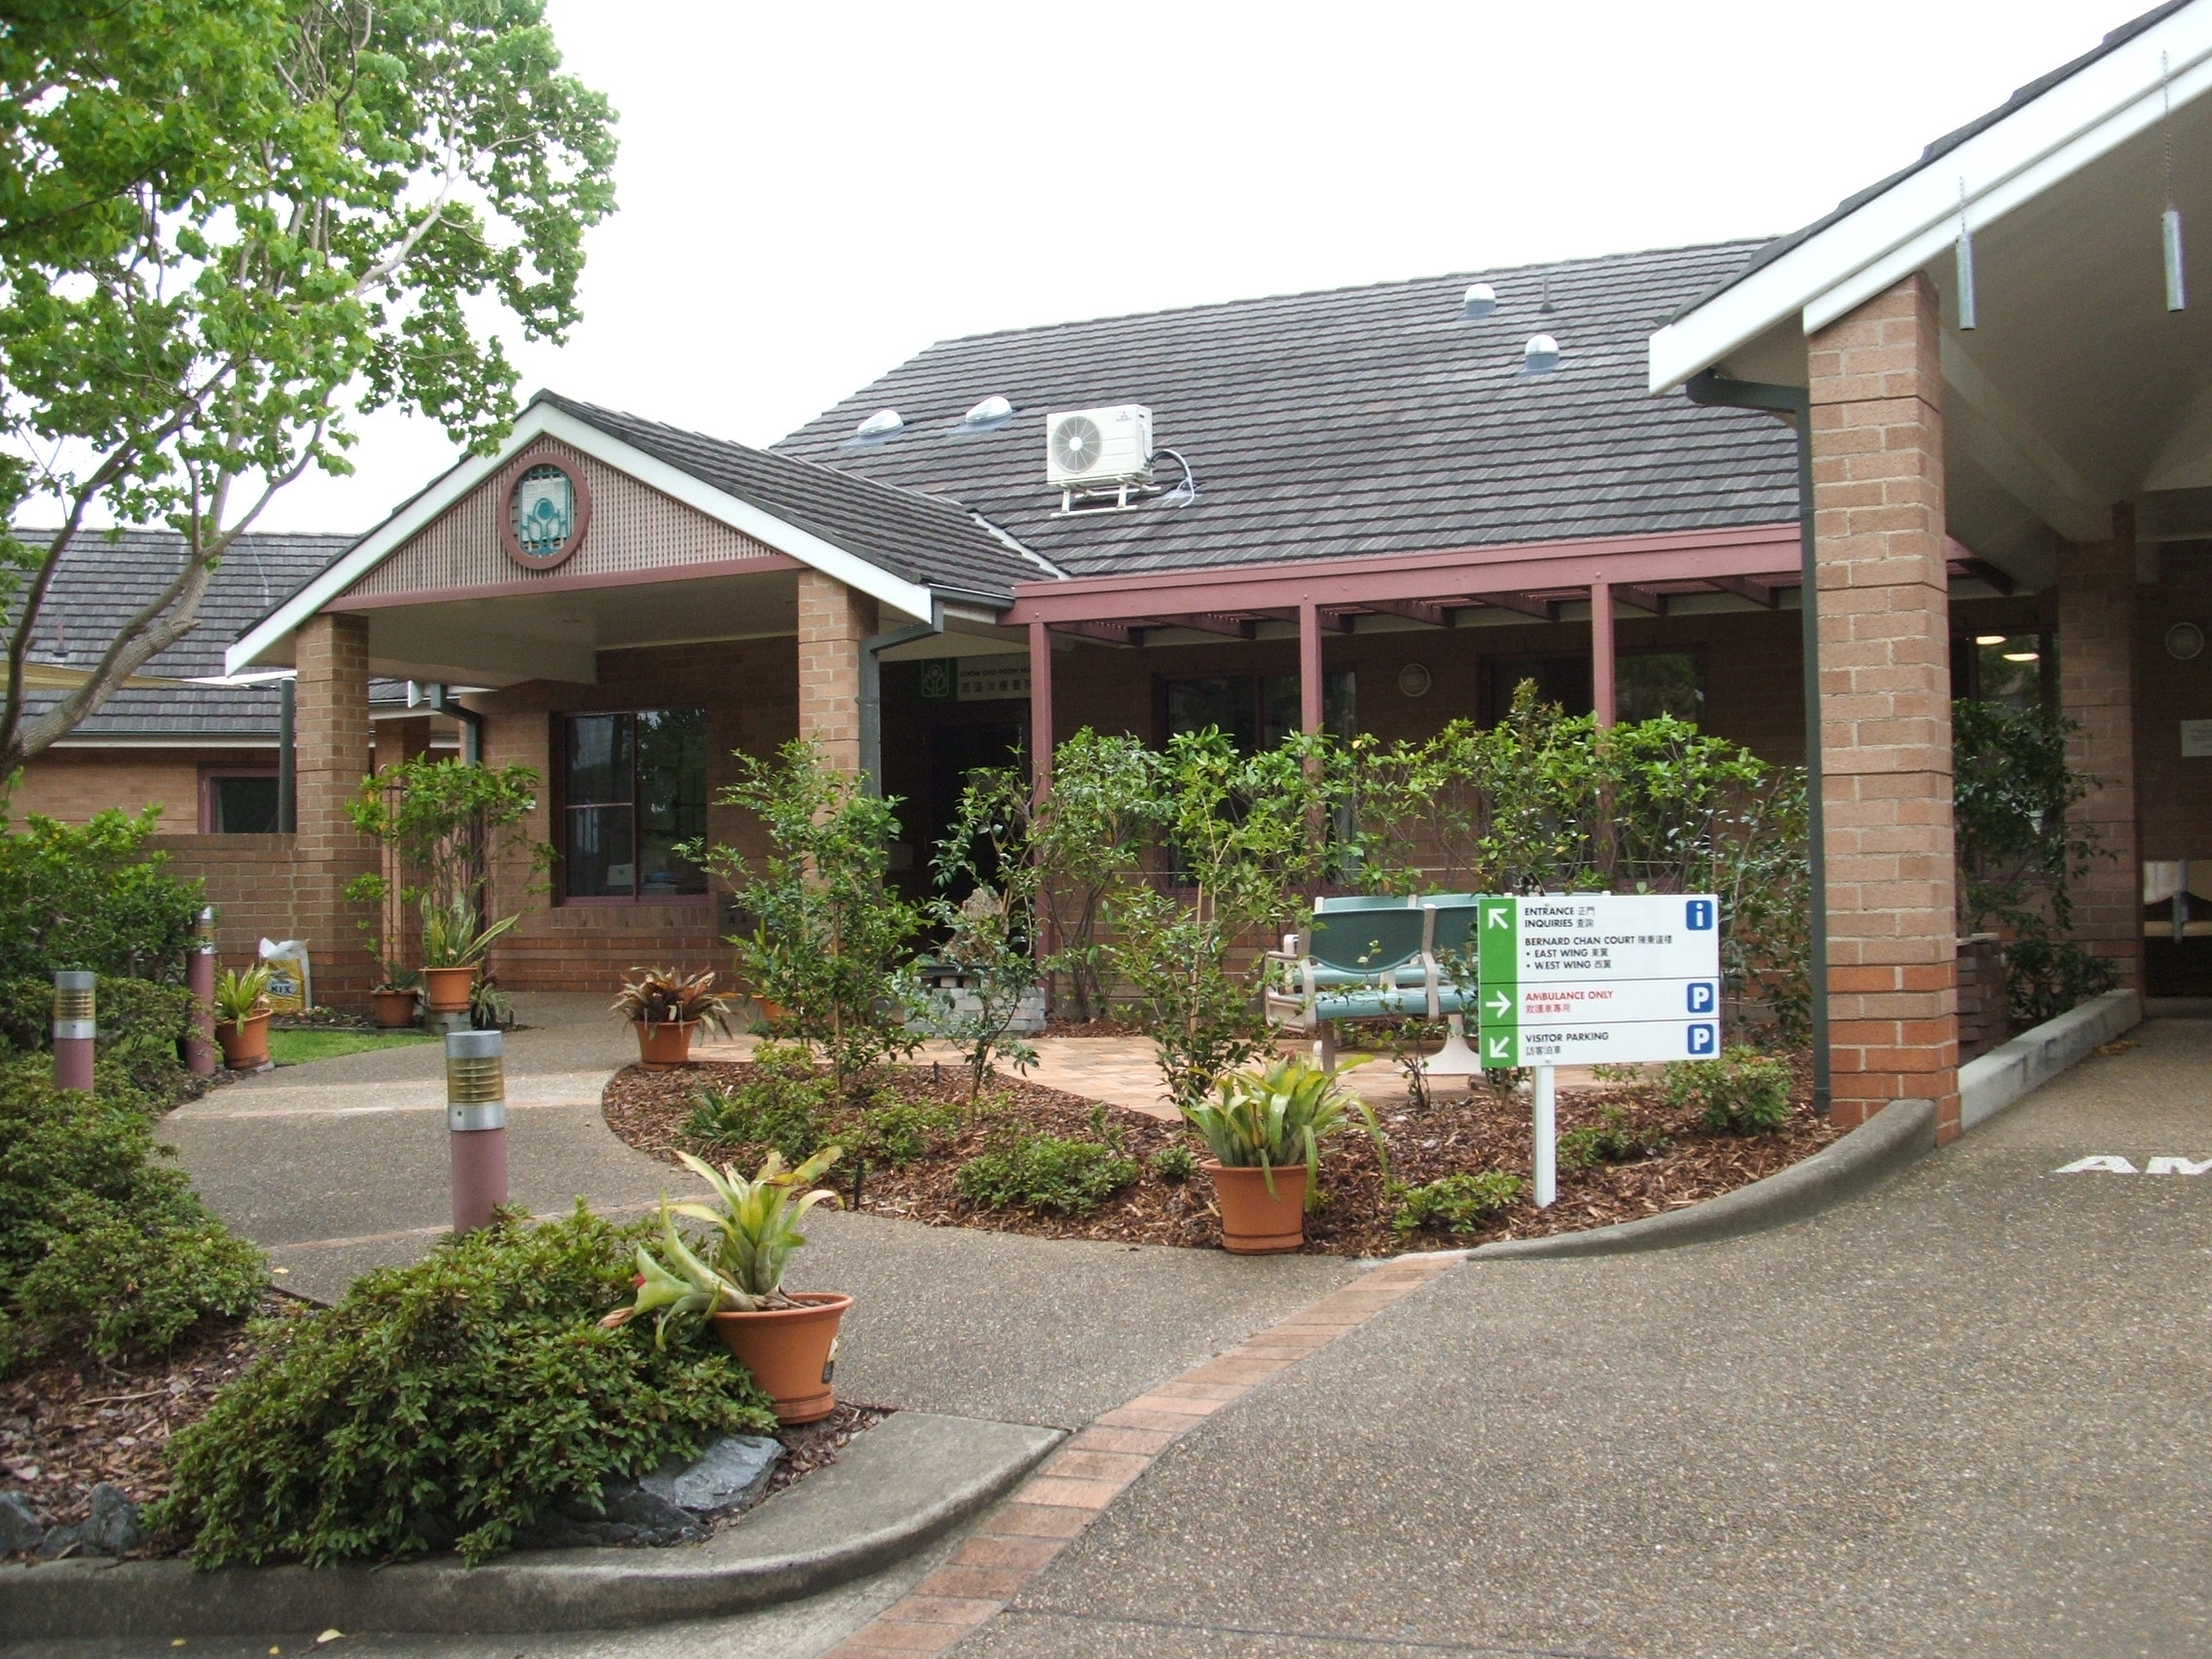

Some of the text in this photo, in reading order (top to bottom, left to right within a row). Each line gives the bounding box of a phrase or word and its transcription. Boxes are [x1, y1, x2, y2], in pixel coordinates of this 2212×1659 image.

[1525, 906, 1595, 916] ENTRANCE 正門
[1525, 919, 1573, 928] INQUIRIES
[1525, 937, 1570, 946] BERNARD
[1573, 937, 1602, 945] CHAN
[1604, 936, 1635, 945] COURT
[1534, 949, 1558, 958] EAST
[1560, 948, 1589, 957] WING
[1534, 961, 1561, 970] WEST
[1564, 960, 1592, 970] WING
[1526, 990, 1613, 1001] AMBULANCE ONLY
[1526, 1031, 1609, 1043] VISITOR PARKING
